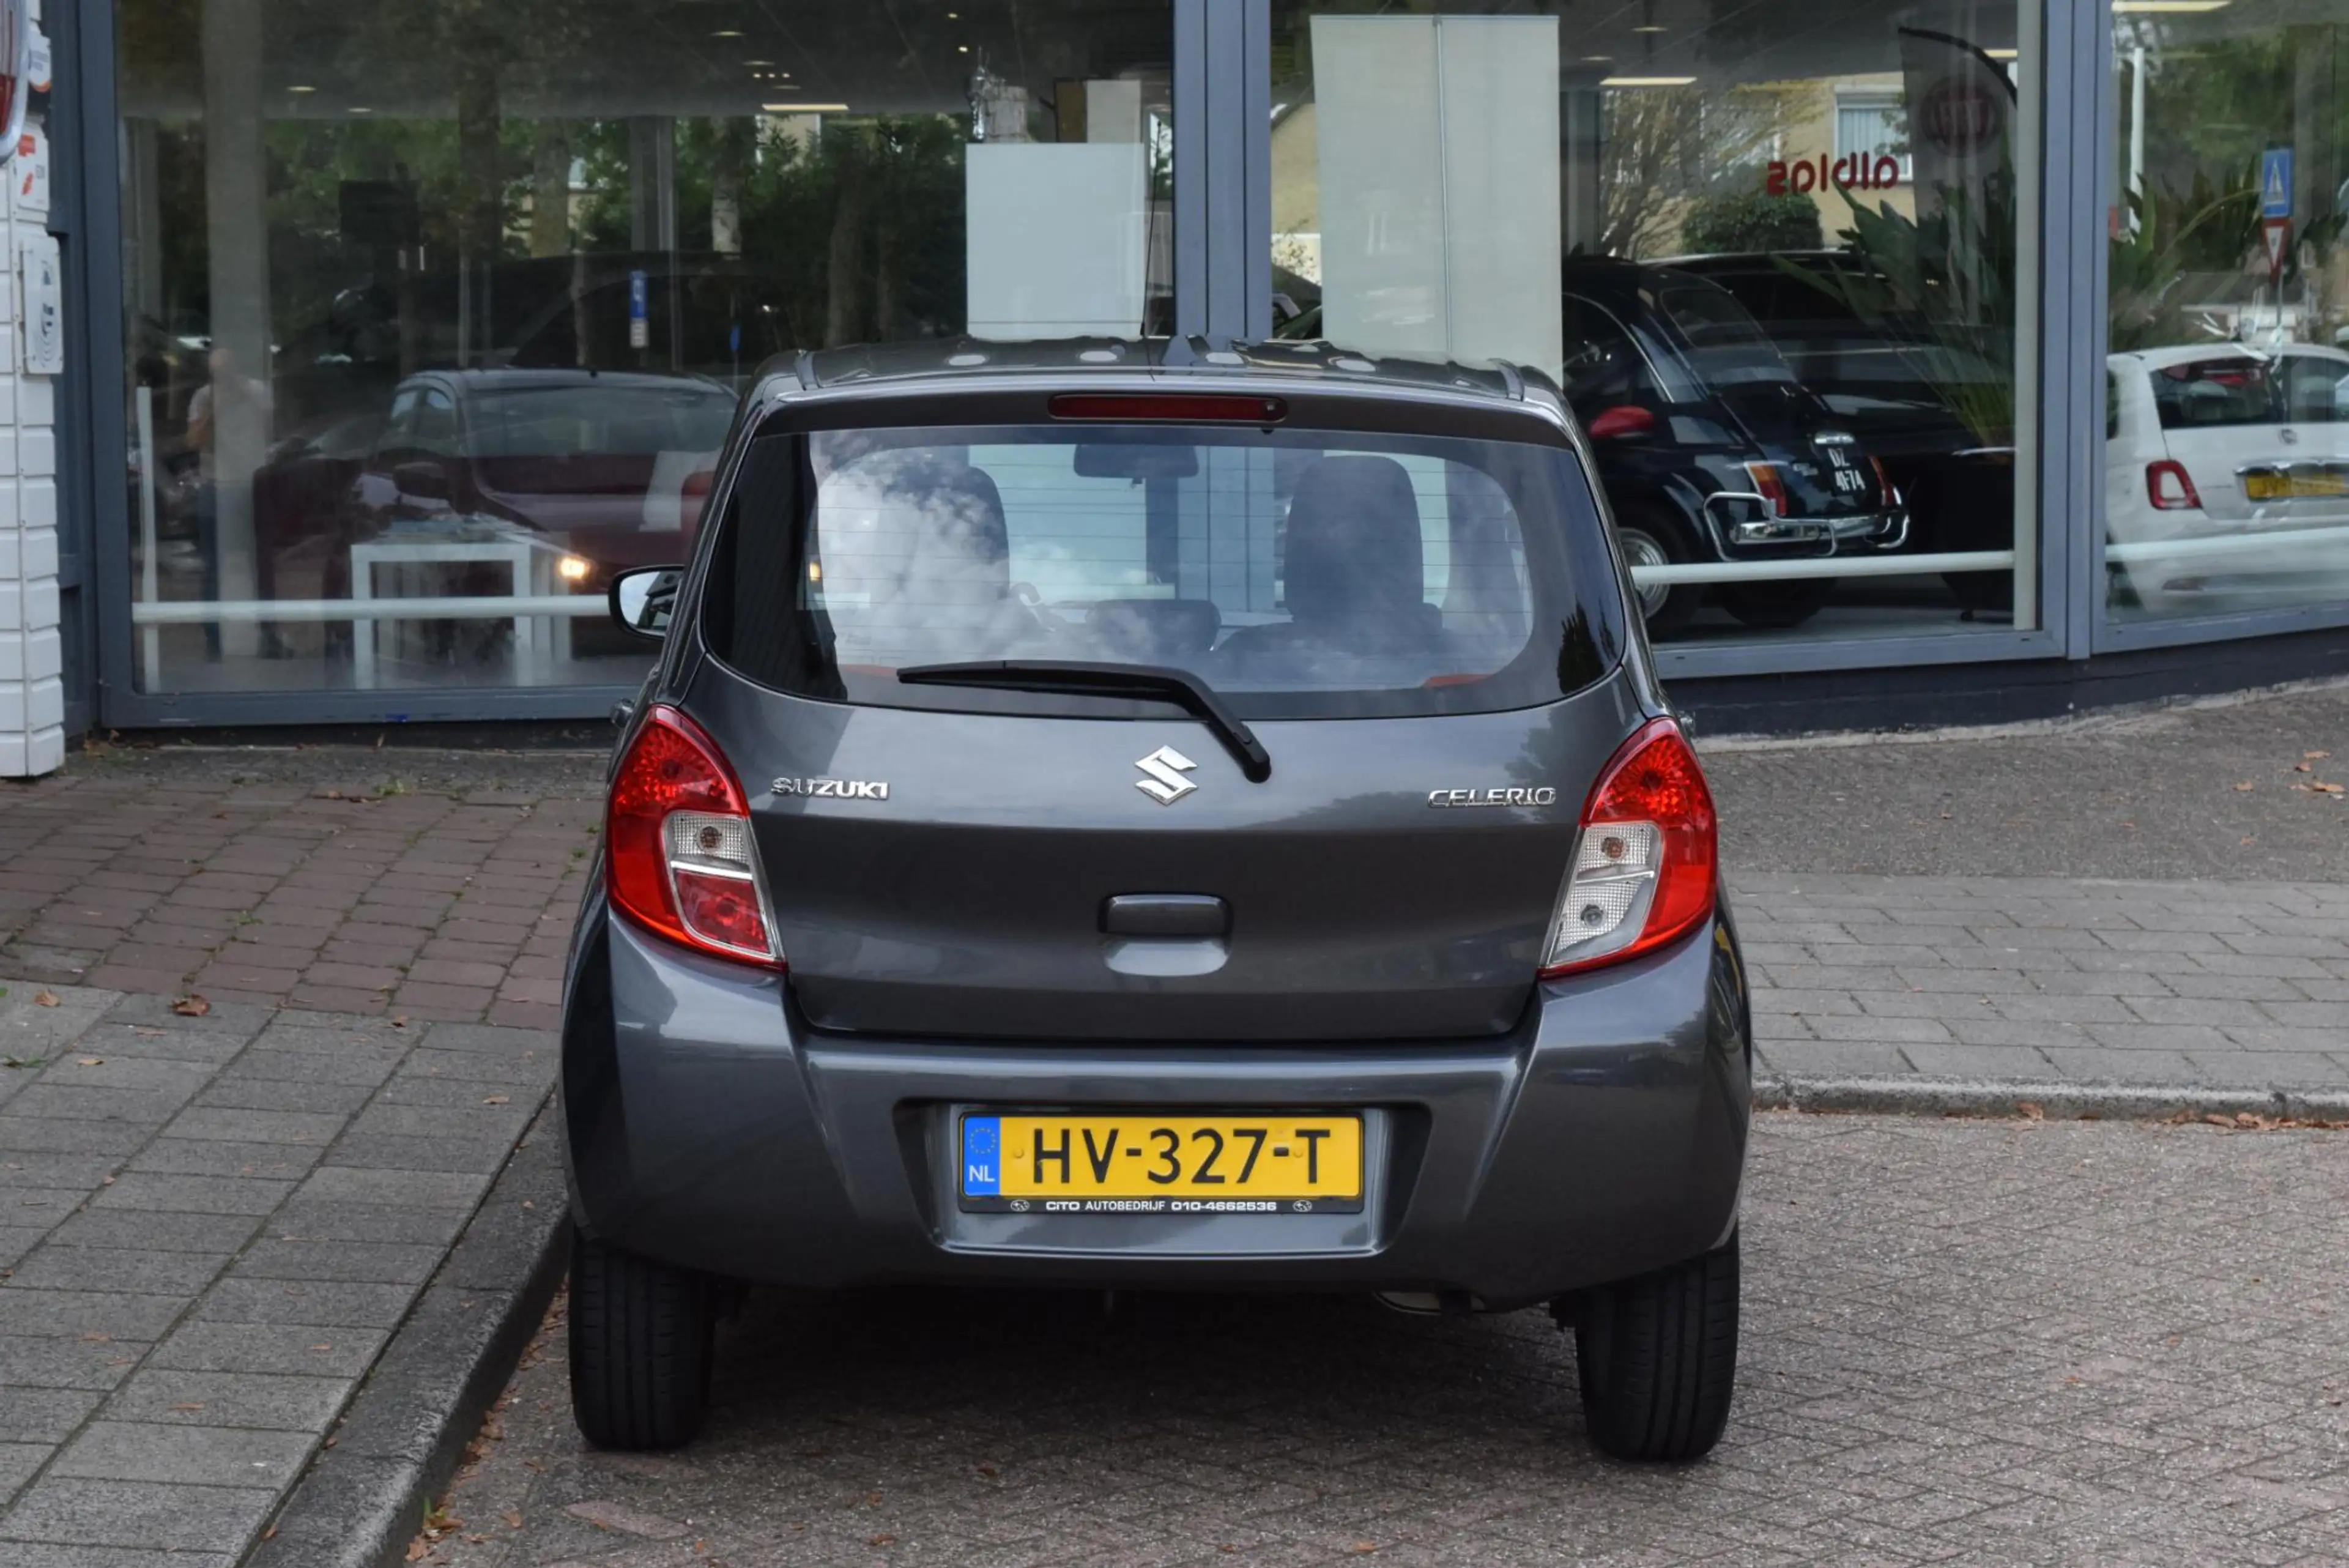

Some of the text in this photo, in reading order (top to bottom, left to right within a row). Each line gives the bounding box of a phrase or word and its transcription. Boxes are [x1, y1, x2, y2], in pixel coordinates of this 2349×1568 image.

[771, 777, 889, 800] SUZUKI
[1428, 787, 1557, 808] CELERIO
[1033, 1128, 1331, 1184] HV-327-T
[968, 1165, 995, 1183] NL
[1085, 1200, 1166, 1211] AUTOBEDRIJF
[1171, 1202, 1277, 1211] 010-4662536
